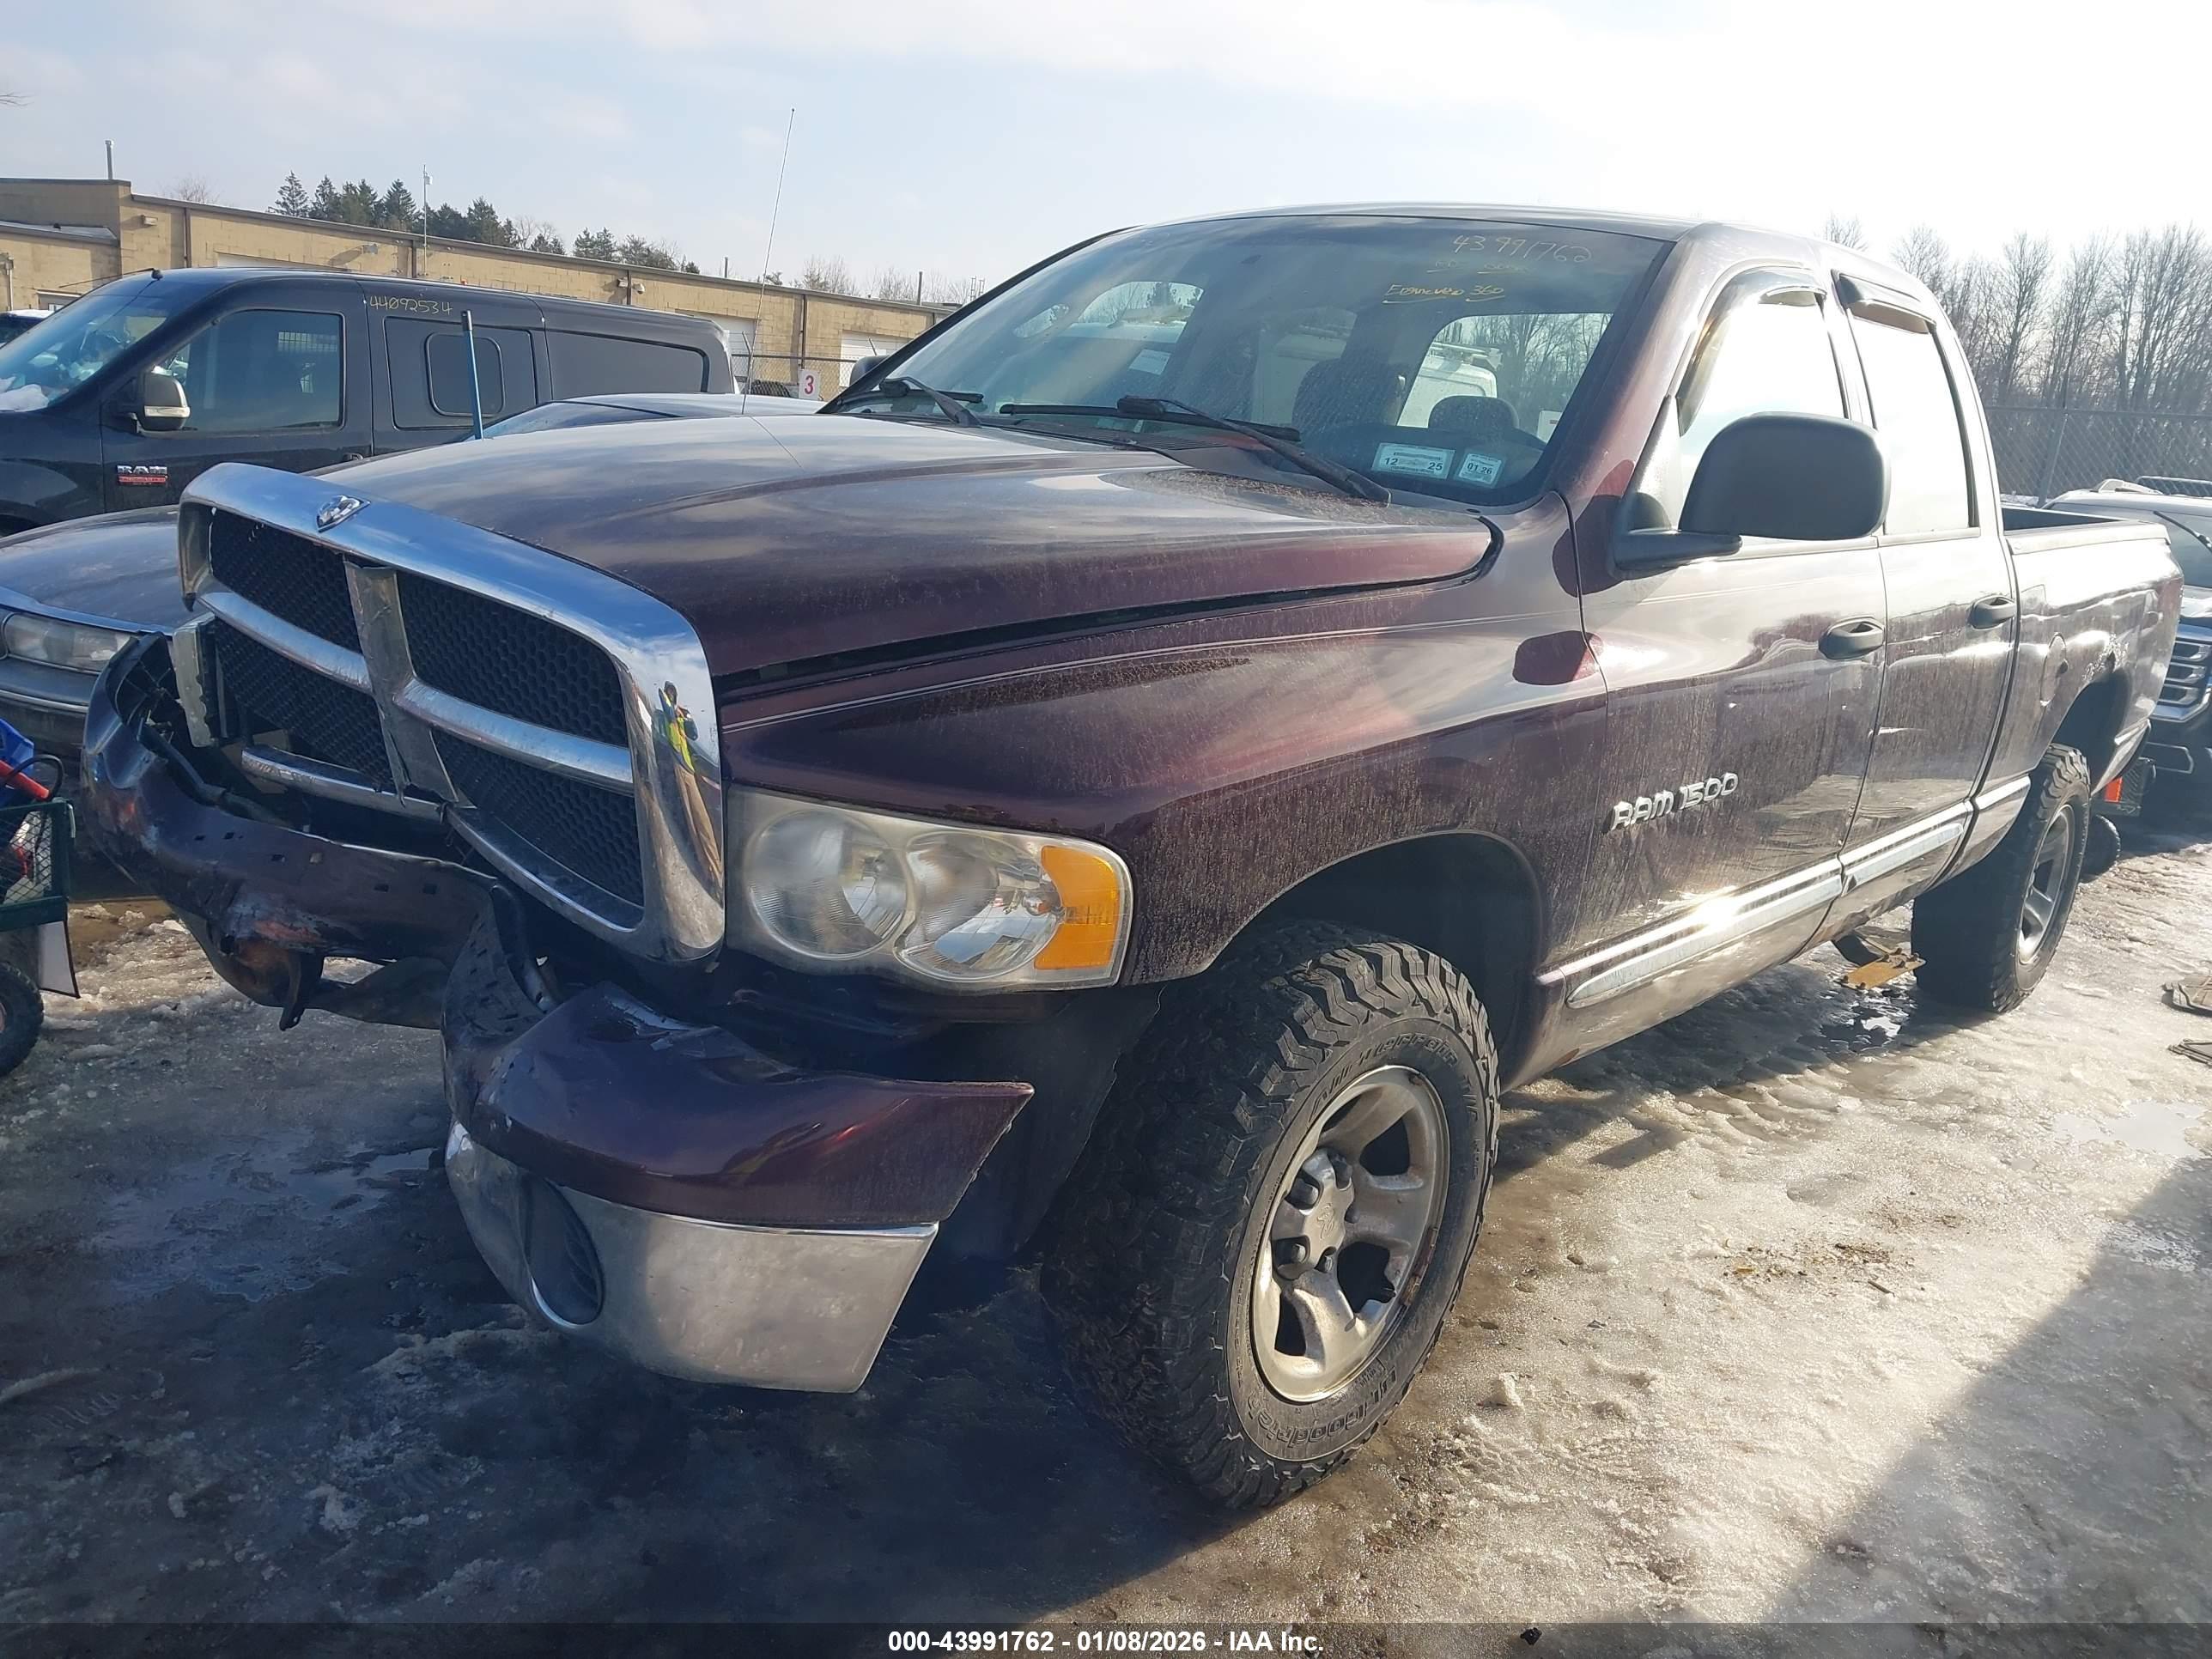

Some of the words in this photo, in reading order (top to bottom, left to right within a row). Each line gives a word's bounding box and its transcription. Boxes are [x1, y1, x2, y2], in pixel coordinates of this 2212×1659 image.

[369, 295, 453, 315] 44092534
[804, 374, 815, 395] 3
[117, 465, 167, 475] RAM
[1384, 457, 1398, 466] 12
[1427, 461, 1443, 471] 25
[1467, 462, 1478, 471] 01
[1480, 465, 1492, 475] 26
[1610, 789, 1674, 830] RAM
[1678, 771, 1739, 811] 1500
